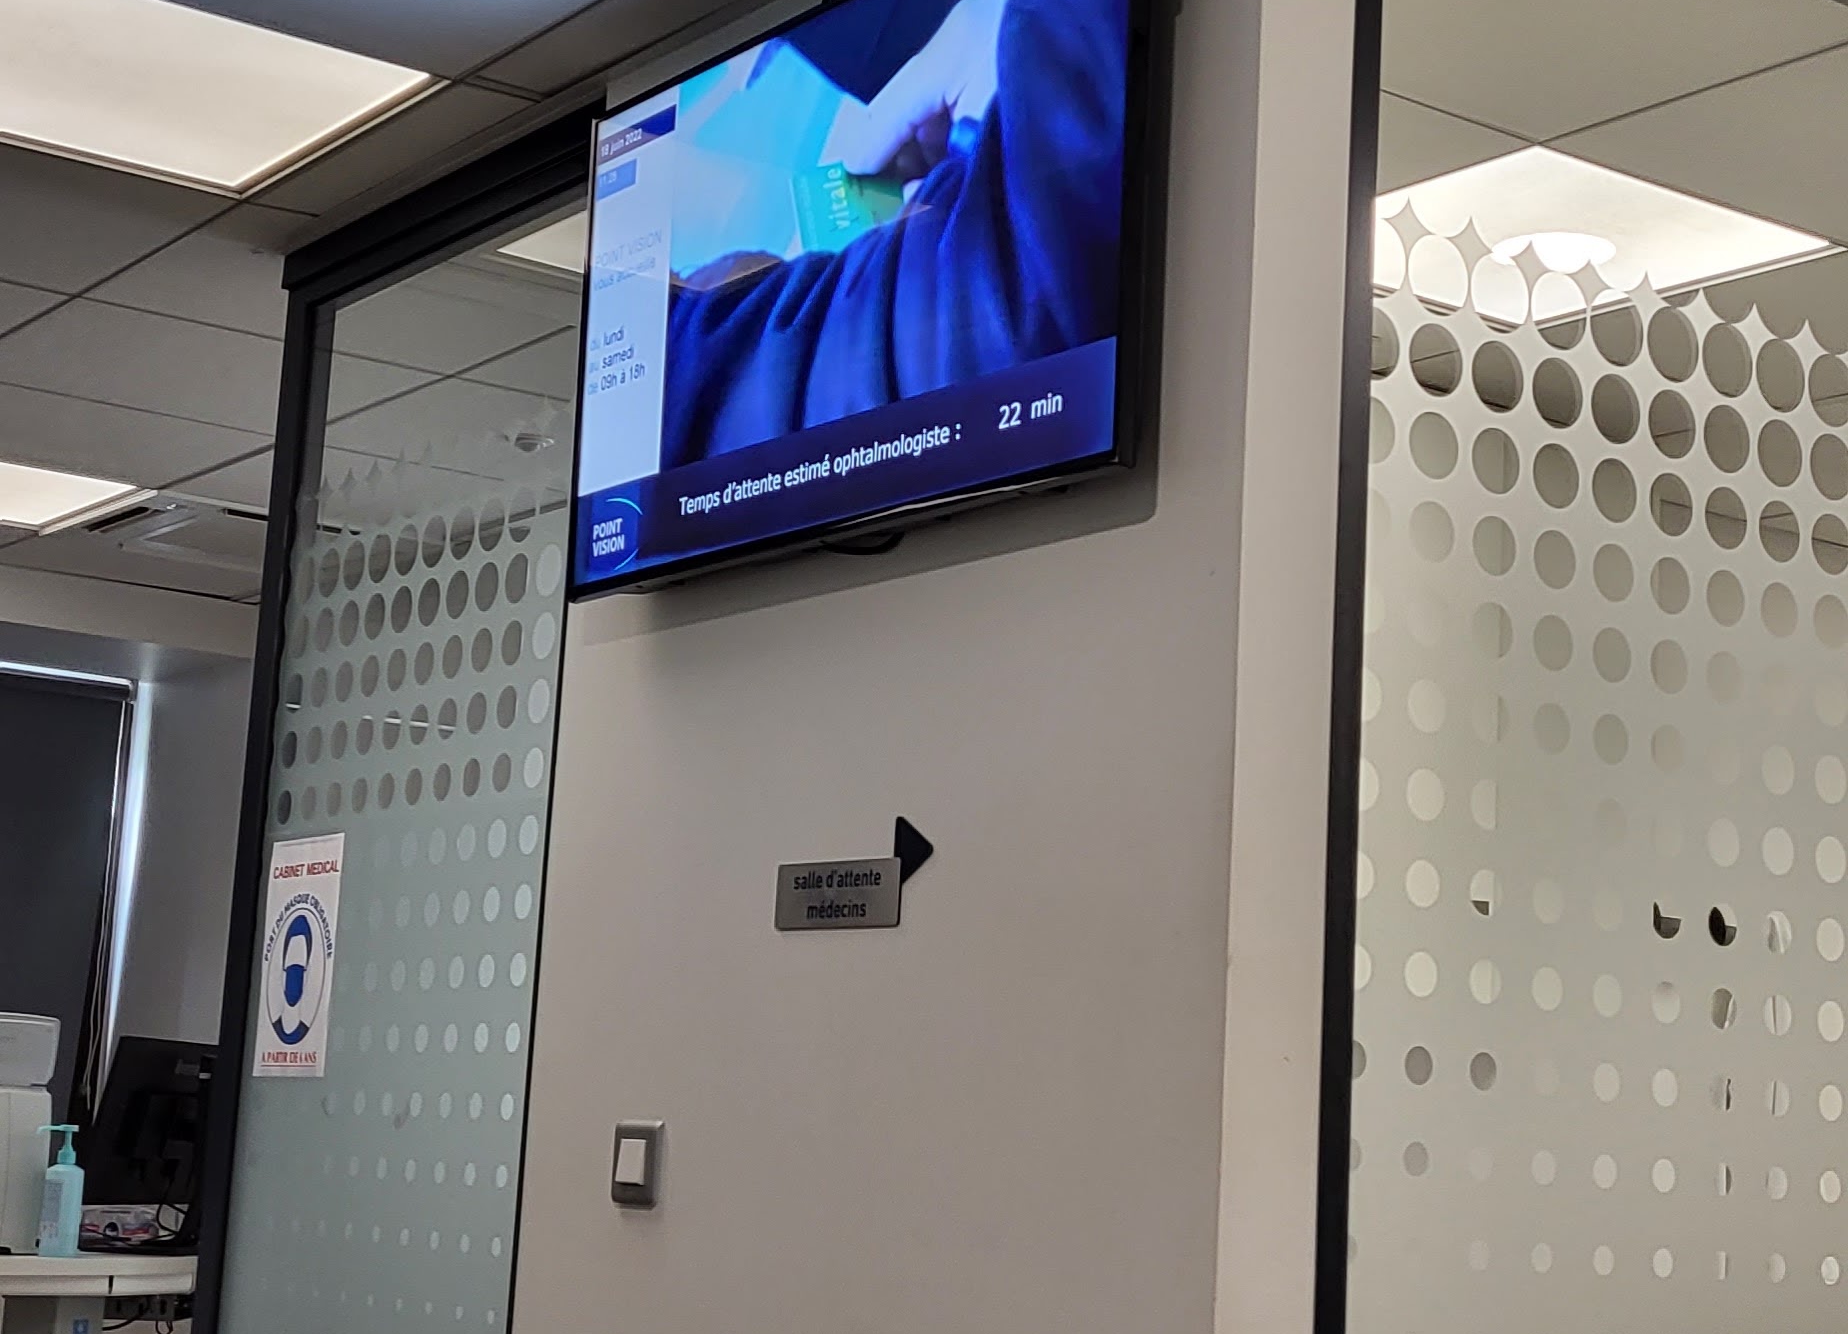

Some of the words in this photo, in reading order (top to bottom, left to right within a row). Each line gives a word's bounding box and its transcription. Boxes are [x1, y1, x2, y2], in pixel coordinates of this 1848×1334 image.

[625, 128, 643, 146] 2022
[823, 167, 851, 229] vitale
[627, 228, 662, 255] VISION
[601, 373, 617, 391] 09h
[630, 363, 646, 381] 18h
[998, 401, 1022, 430] 22
[1030, 392, 1064, 420] min
[679, 490, 720, 516] Temps
[784, 453, 830, 487] estimé
[833, 424, 951, 476] ophtalmologiste
[592, 518, 623, 540] POINT
[592, 534, 625, 557] VISION
[273, 864, 305, 879] CABINET
[306, 860, 339, 876] MEDICAL
[793, 871, 823, 890] salle
[826, 869, 881, 889] d'attente
[806, 899, 867, 920] médecins
[264, 929, 277, 962] PORT
[284, 893, 310, 915] MASQUE
[310, 895, 333, 960] OBLIGATOIRE
